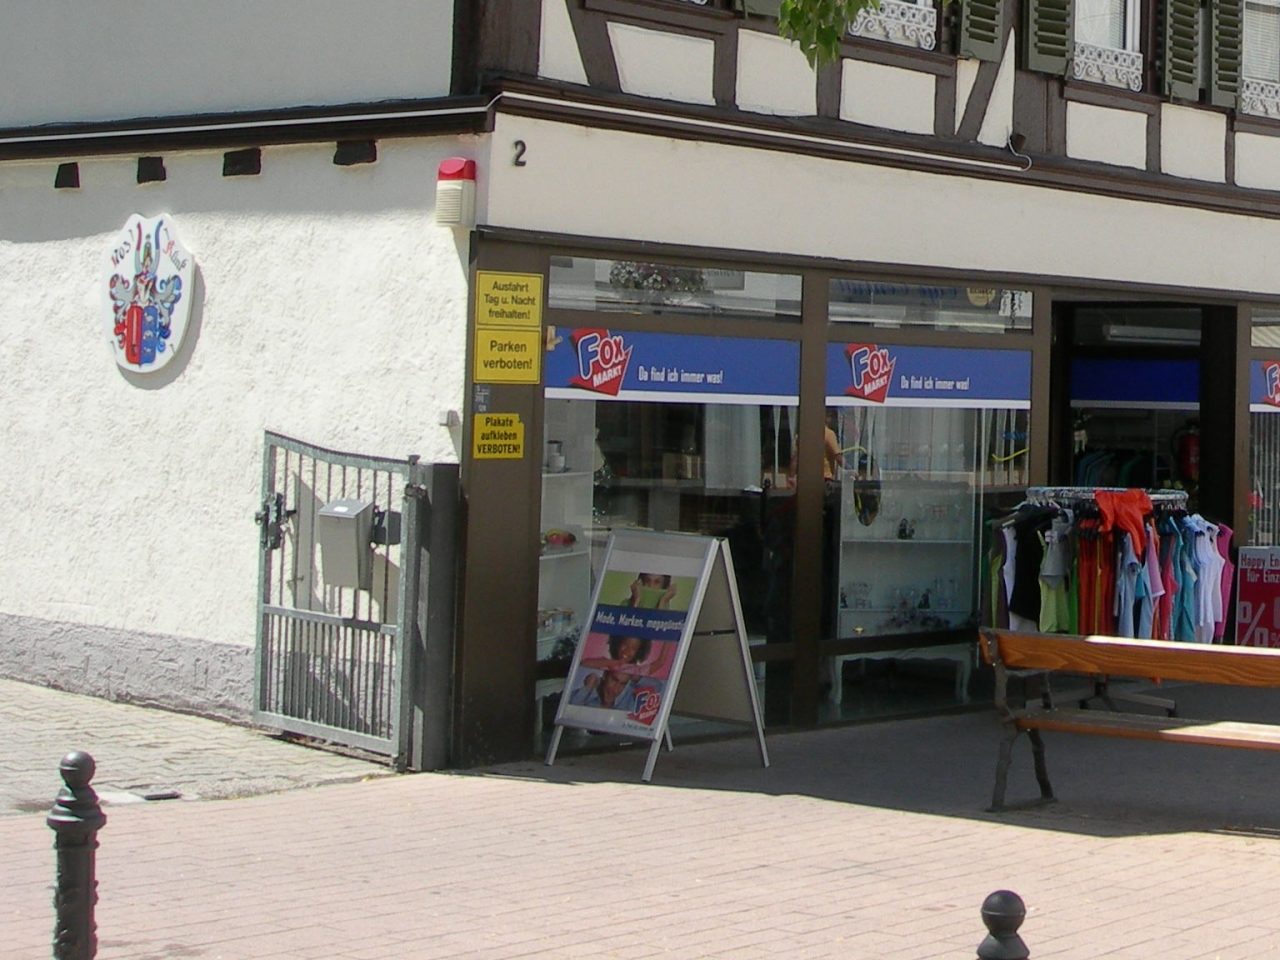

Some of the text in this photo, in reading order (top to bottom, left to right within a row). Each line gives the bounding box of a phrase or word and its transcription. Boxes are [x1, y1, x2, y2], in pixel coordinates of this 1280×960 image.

[514, 140, 527, 166] 2
[492, 281, 529, 293] Ausfahrt
[484, 293, 536, 306] Tag u. Nacht
[488, 309, 531, 320] freihalten!
[490, 340, 527, 352] Parken
[578, 332, 626, 380] FOX
[483, 358, 533, 370] verboten!
[852, 347, 891, 389] FOX
[593, 365, 623, 388] MARKT
[638, 366, 723, 384] Da find ich immer was!
[864, 375, 888, 396] MARKT
[485, 417, 513, 427] Plakate
[481, 429, 517, 441] aufkleben
[477, 443, 521, 455] VERBOTEN!
[1241, 554, 1266, 569] Happy
[1247, 570, 1260, 582] für
